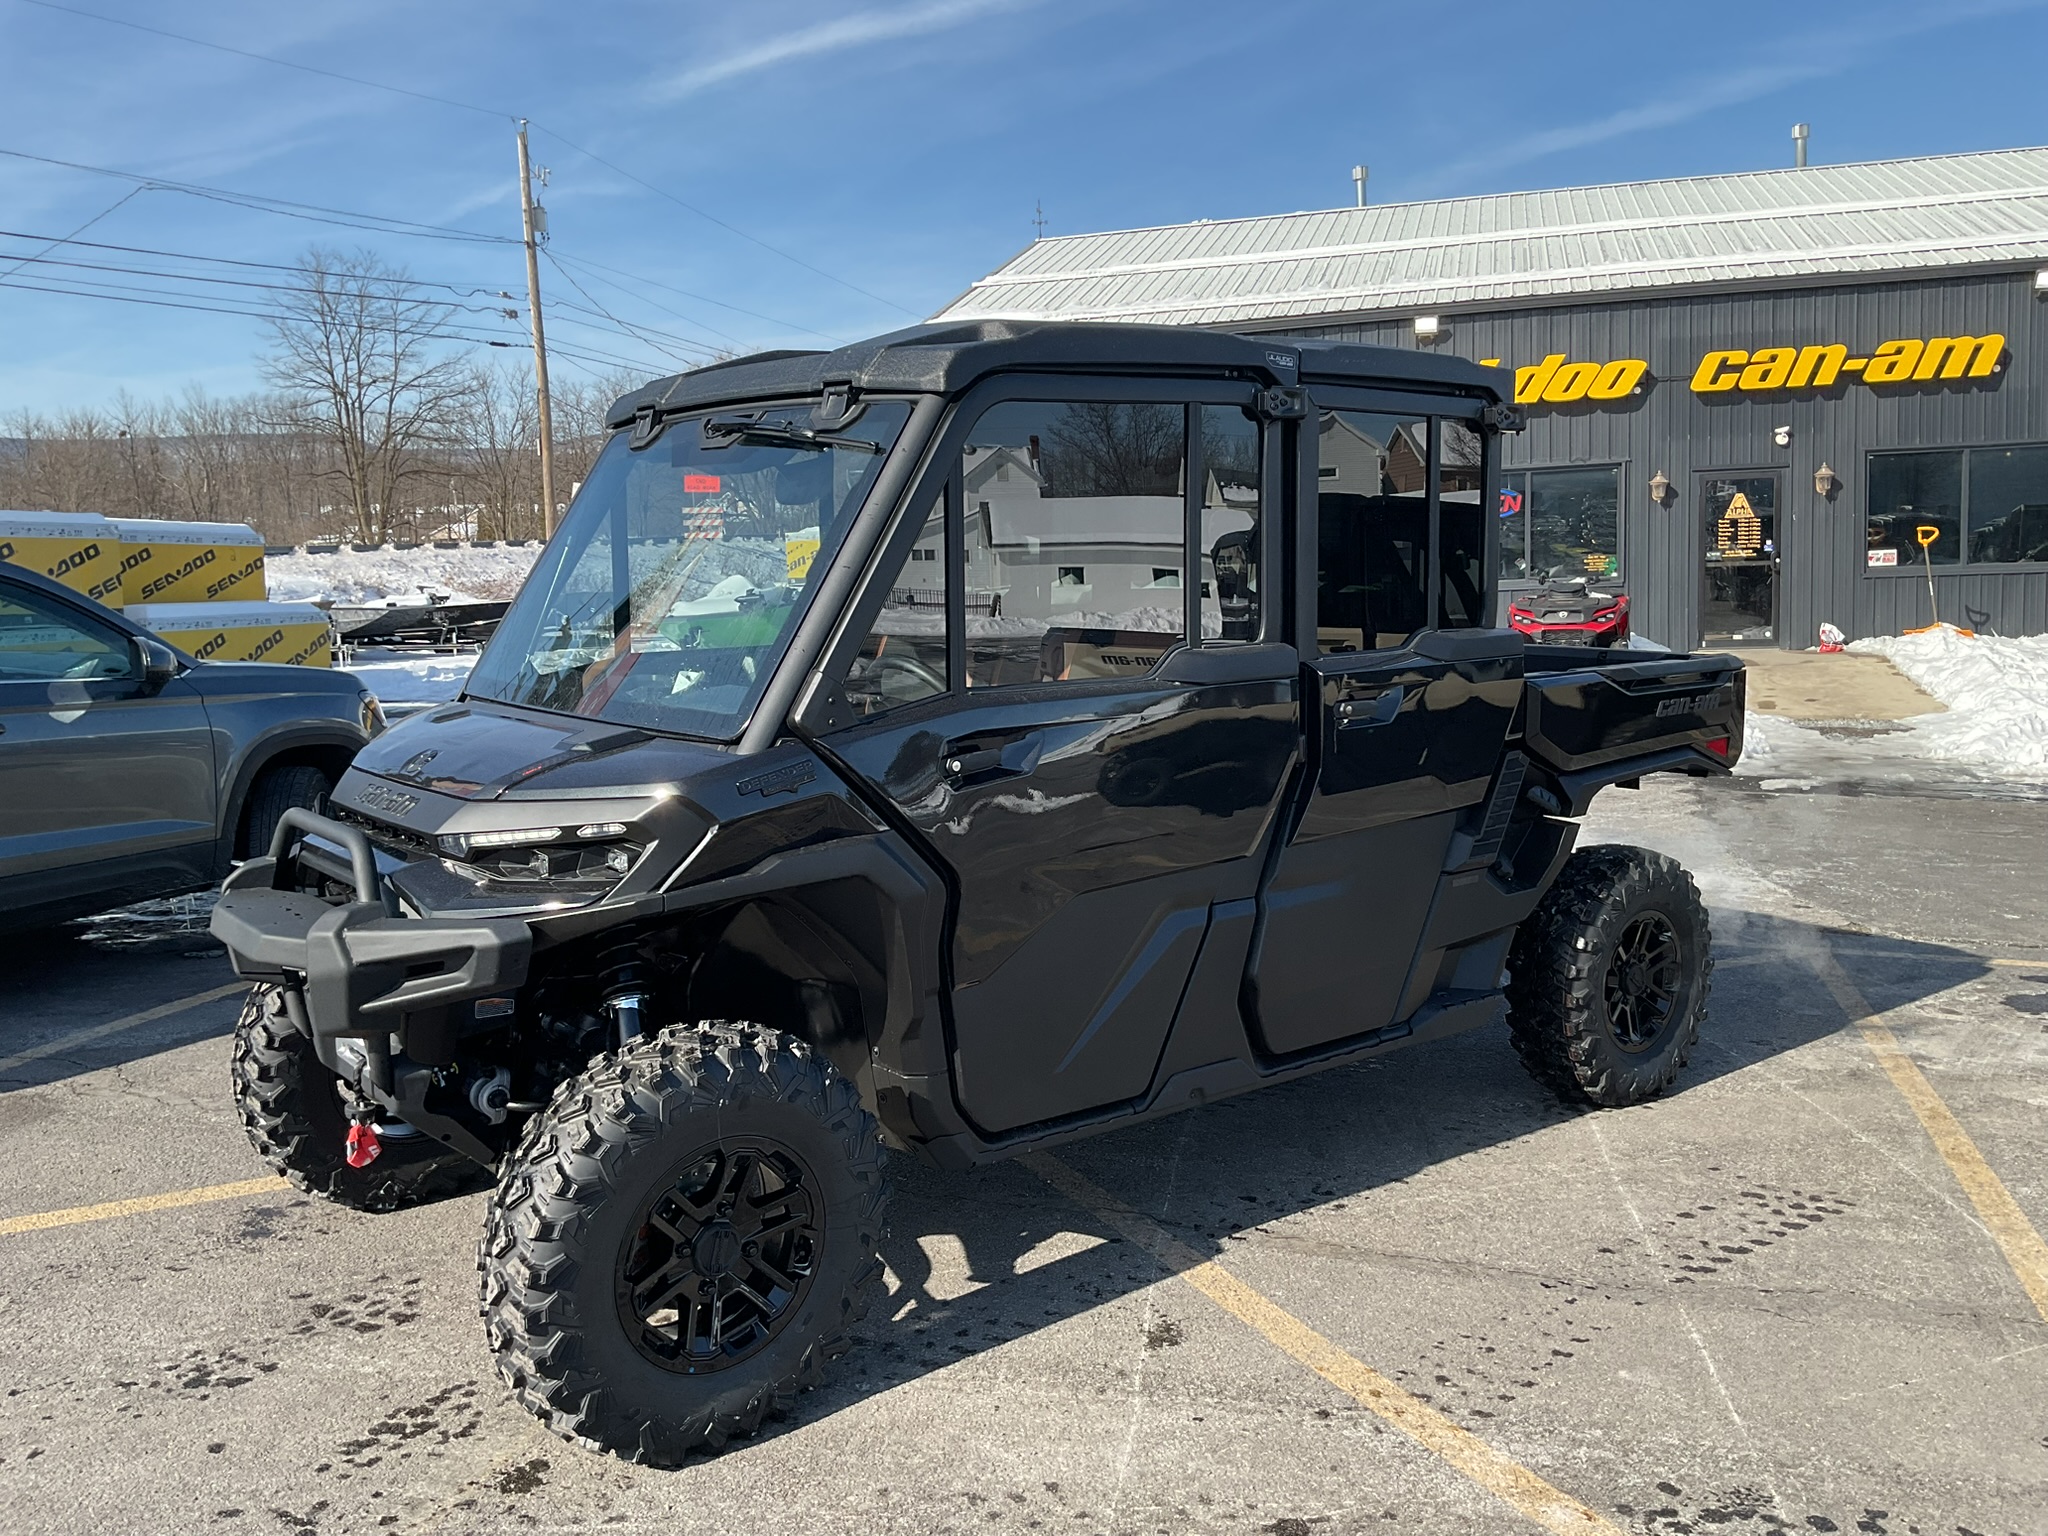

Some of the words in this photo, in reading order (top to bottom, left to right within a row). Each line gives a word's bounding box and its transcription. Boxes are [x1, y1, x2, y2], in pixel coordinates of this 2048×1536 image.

[1479, 353, 1648, 403] doo
[1690, 334, 2005, 392] can-am
[741, 761, 812, 790] DEFENDER
